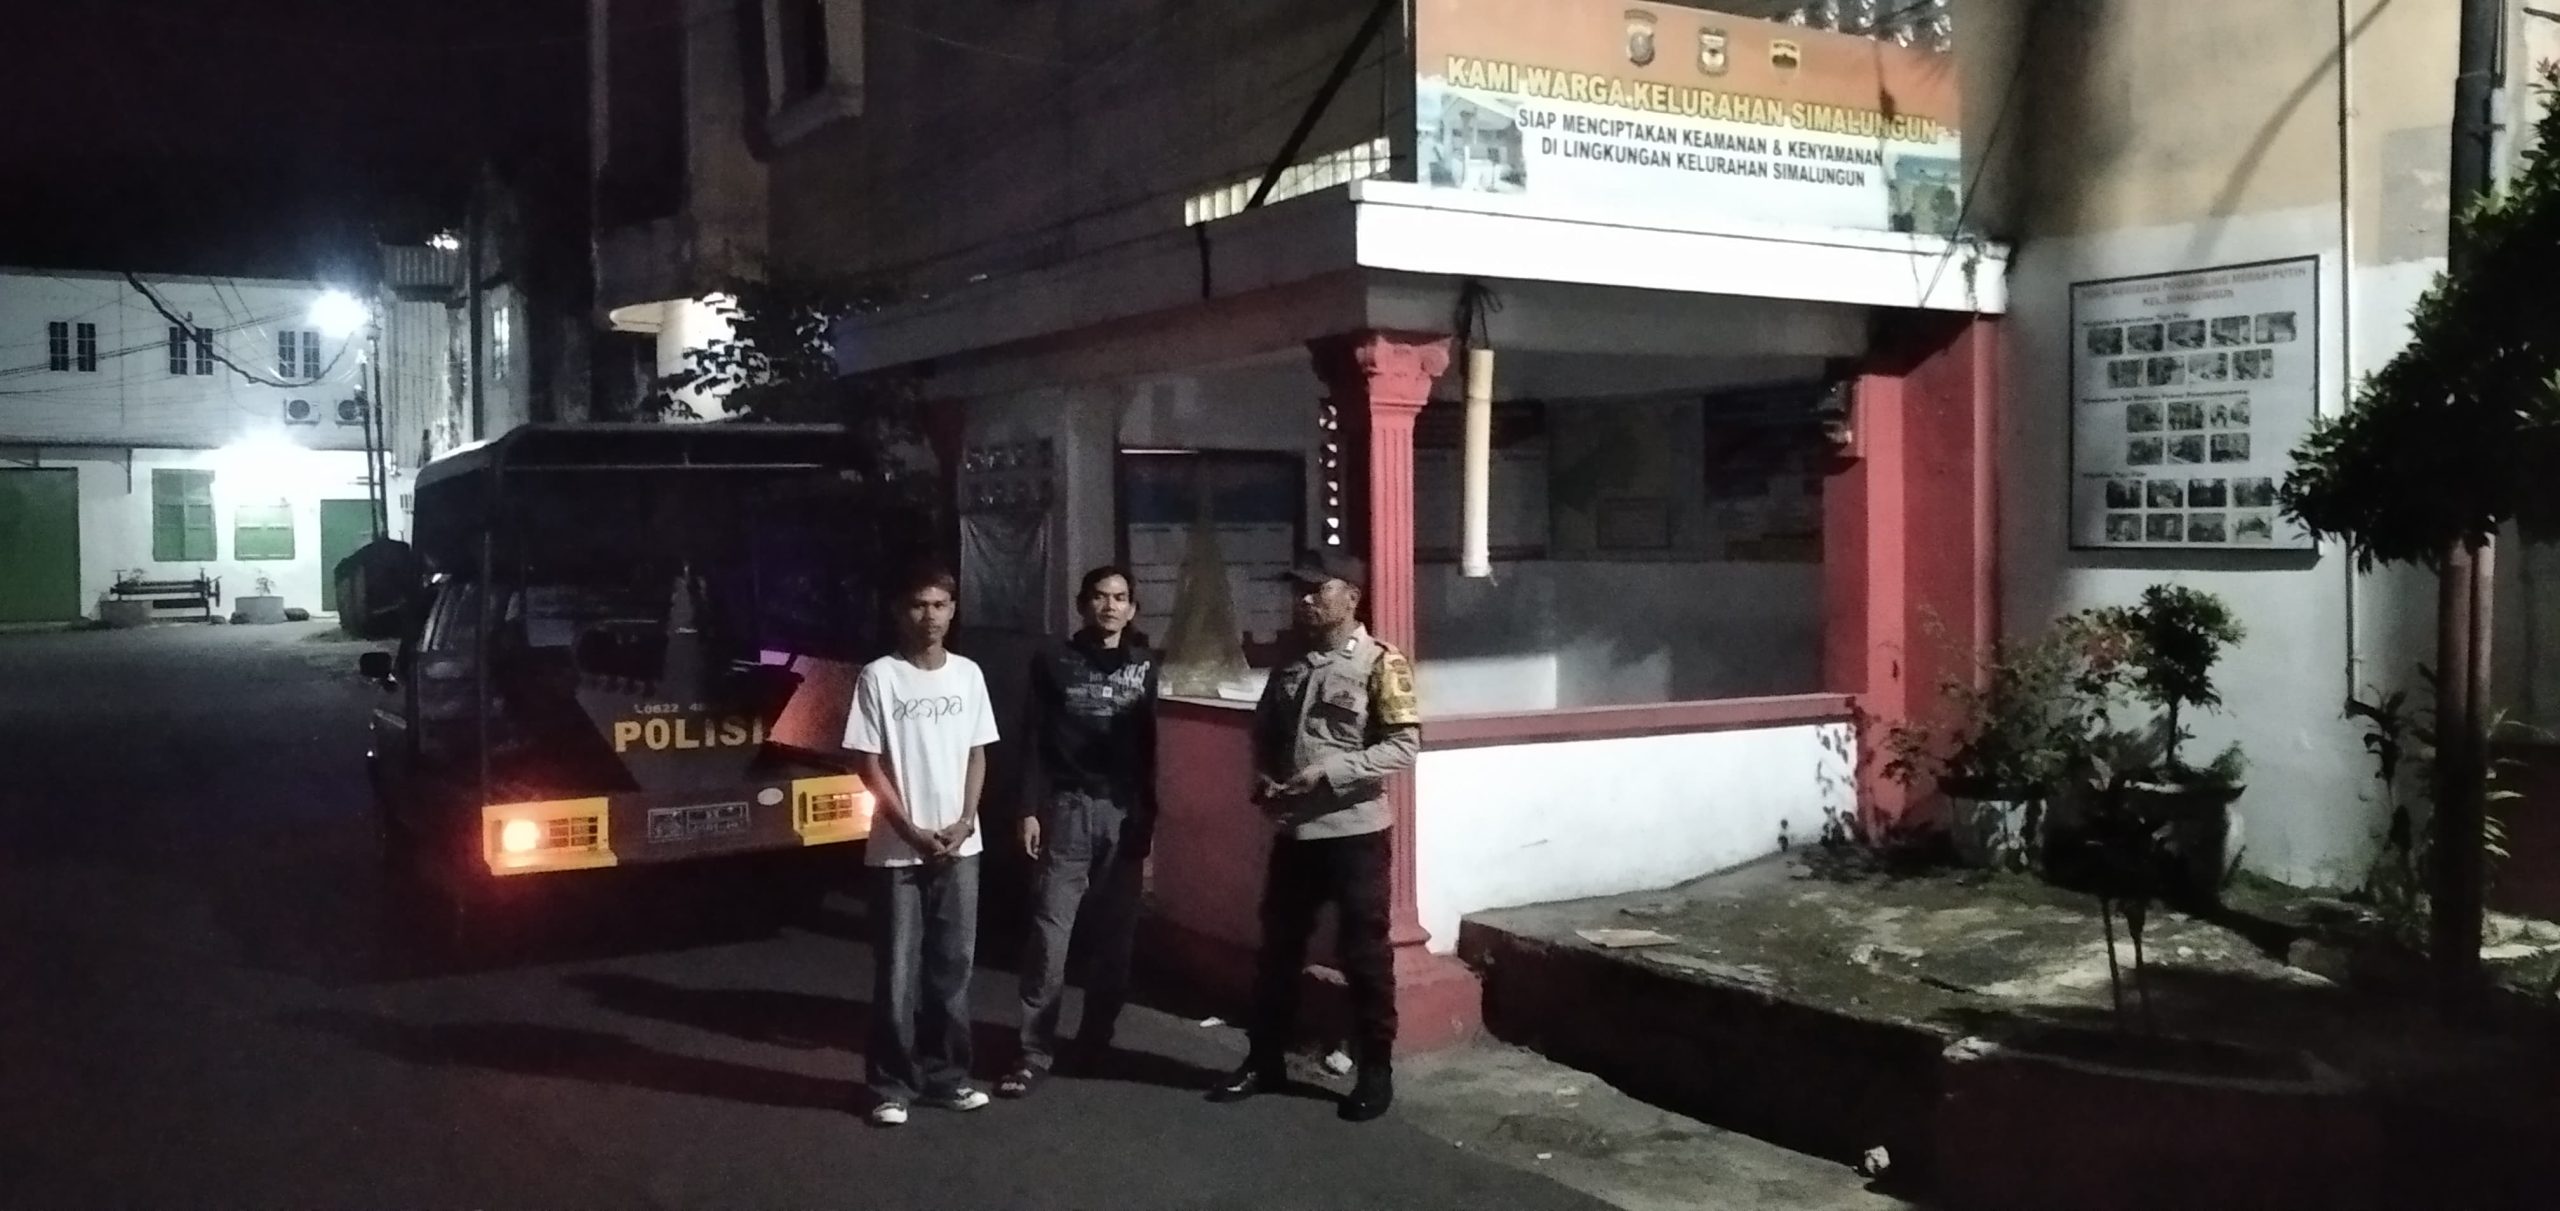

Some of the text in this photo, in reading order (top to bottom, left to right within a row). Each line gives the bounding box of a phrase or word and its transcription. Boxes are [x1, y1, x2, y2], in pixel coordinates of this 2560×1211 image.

[1447, 55, 1938, 145] KAMI WARGA KELURAHAN SIMALUNGUN
[1518, 109, 1884, 167] SIAP MENCIPTAKAN KEAMANAN & KENYAMANAN
[1542, 137, 1865, 187] DI LINGKUNGAN KELURAHAN SIMALUNGUN
[613, 715, 763, 753] POLISI
[892, 695, 963, 725] aespa
